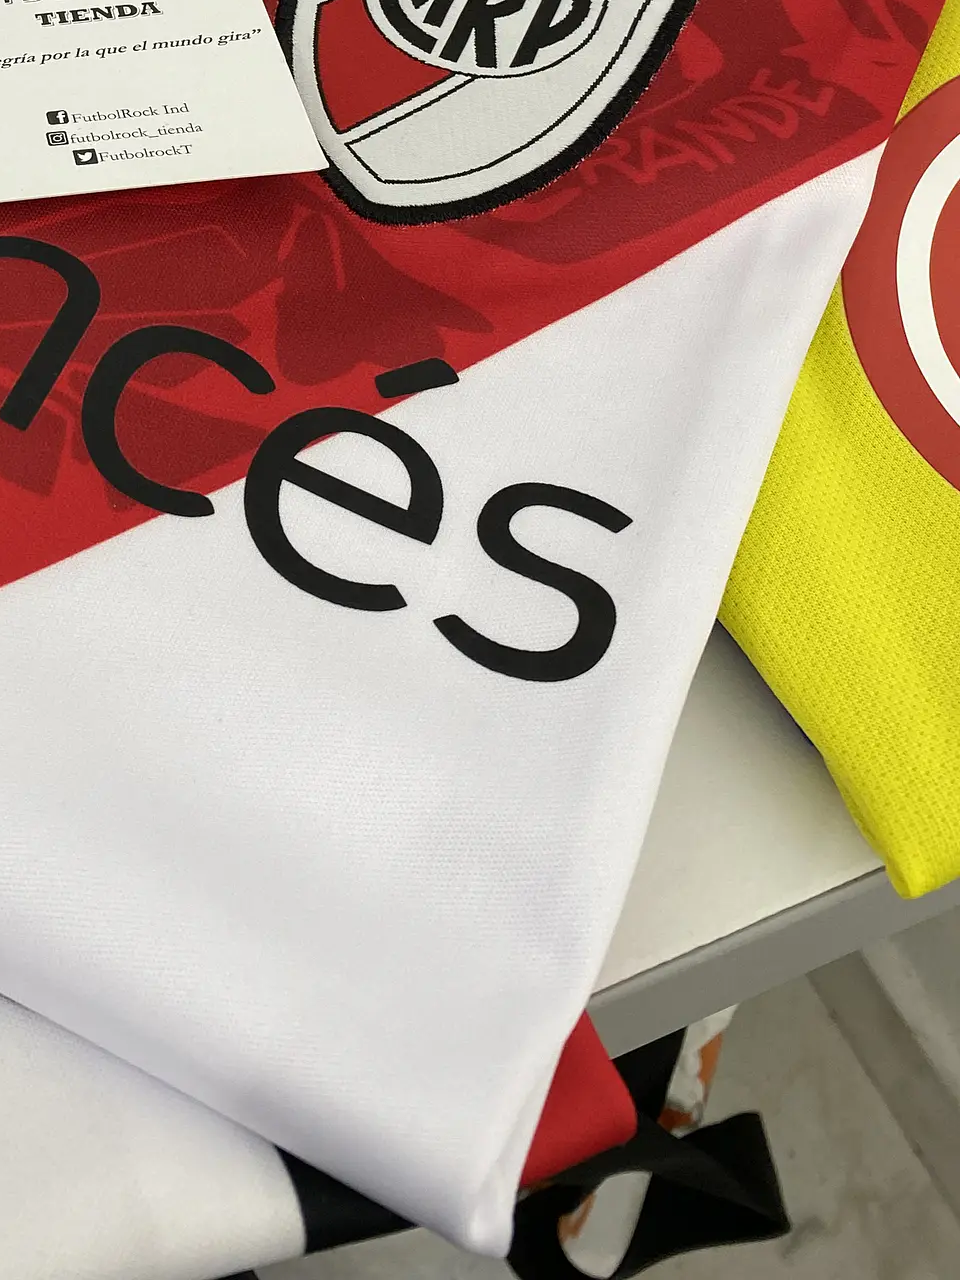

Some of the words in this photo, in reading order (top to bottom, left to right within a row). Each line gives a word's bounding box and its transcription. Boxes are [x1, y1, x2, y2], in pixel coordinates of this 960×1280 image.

[35, 1, 162, 27] TIENDA
[40, 51, 71, 65] por
[75, 47, 90, 58] la
[95, 45, 127, 59] que
[132, 40, 147, 52] el
[152, 34, 213, 50] mundo
[71, 106, 160, 123] FutbolRock
[162, 103, 190, 116] Ind
[70, 122, 203, 144] futbolrock_tienda
[98, 144, 192, 162] FutbolrockT
